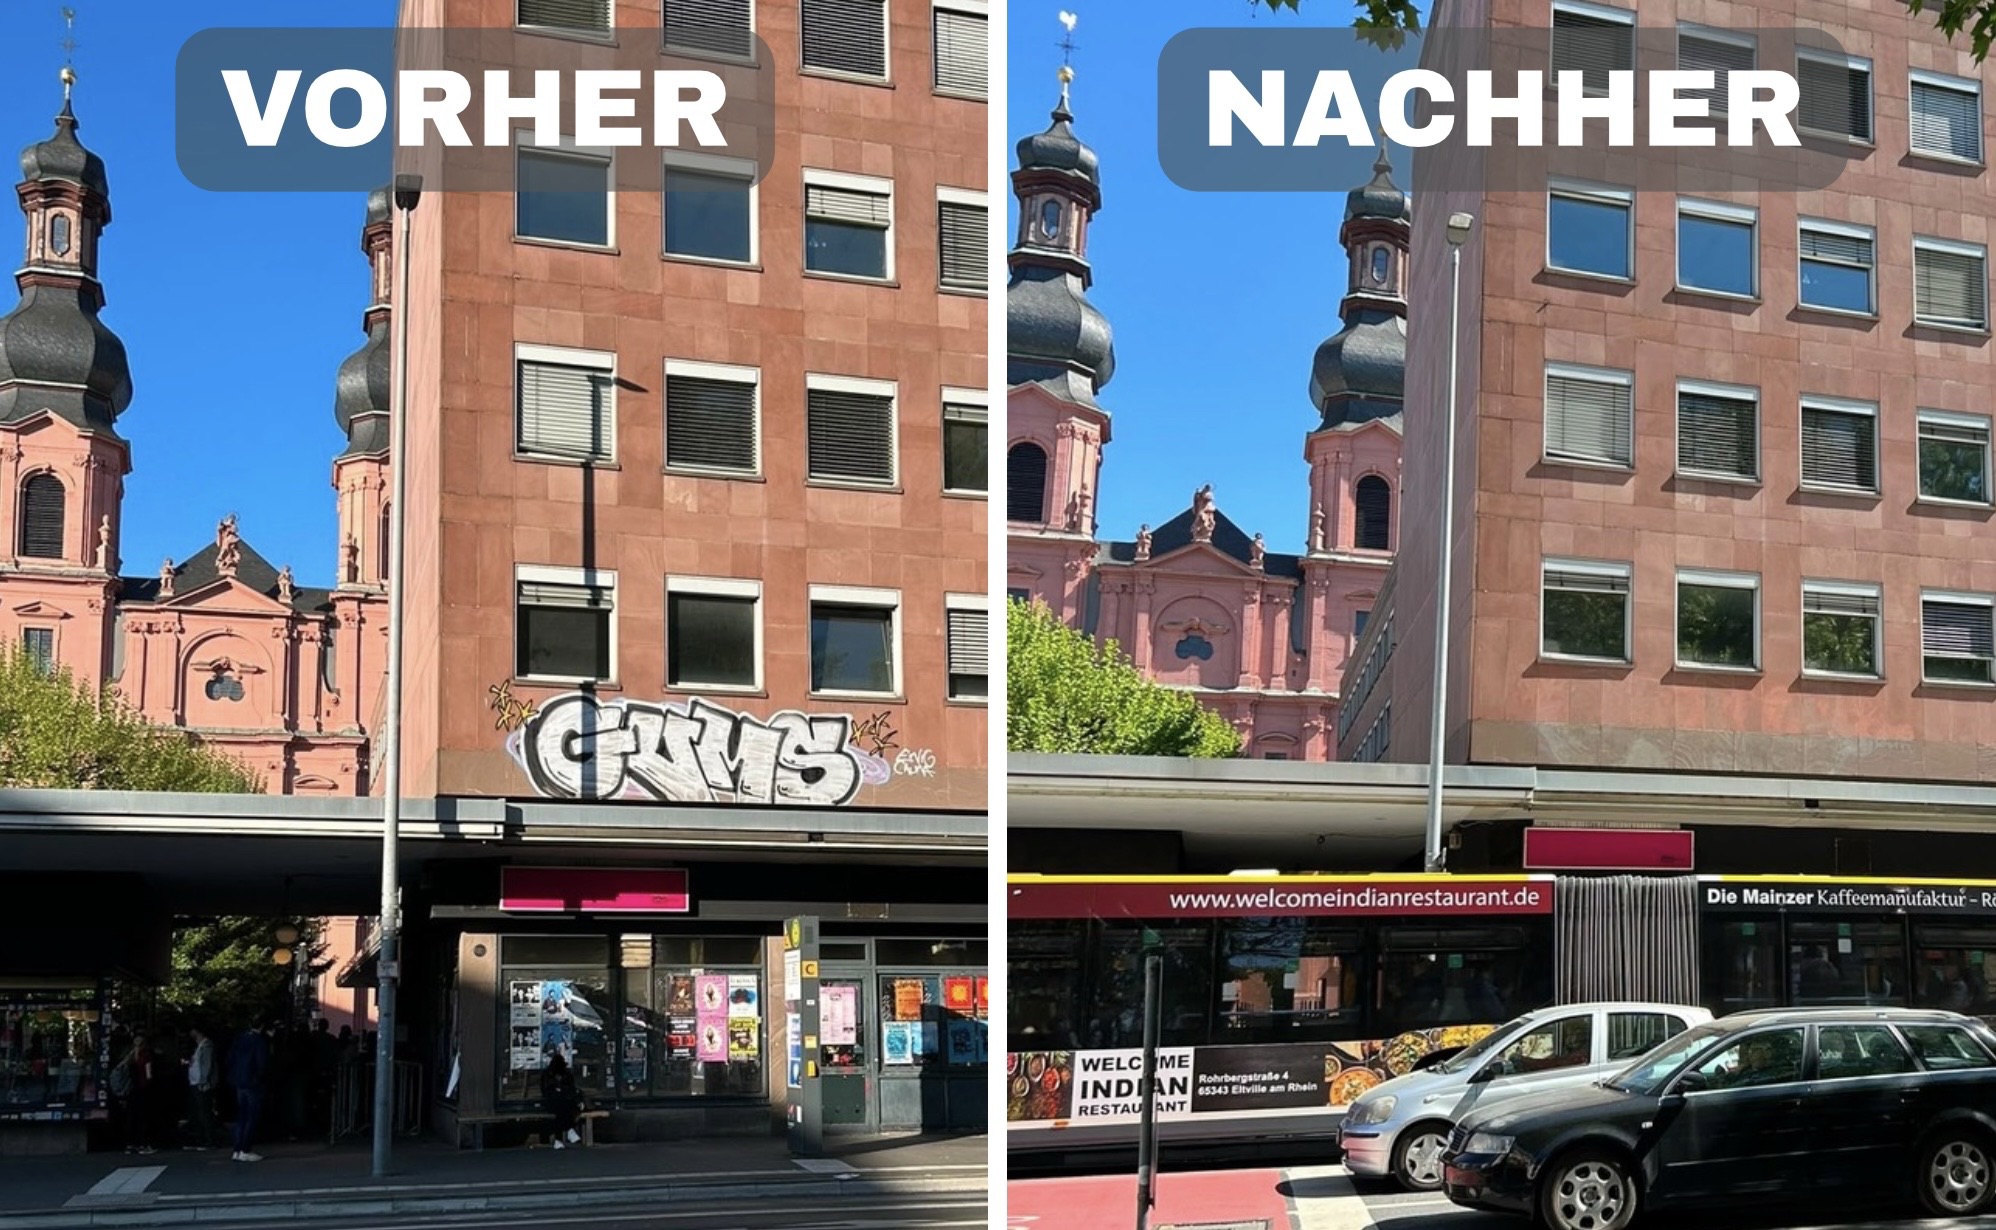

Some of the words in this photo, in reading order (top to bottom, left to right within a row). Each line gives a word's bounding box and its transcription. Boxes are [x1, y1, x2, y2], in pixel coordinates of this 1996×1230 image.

[1170, 887, 1540, 909] www.welcomeindianrestaurant.de
[1707, 888, 1738, 905] Die
[1743, 889, 1814, 905] Mainzer
[1816, 889, 1967, 908] Kaffeemanufaktur
[805, 963, 815, 975] C
[1081, 1054, 1190, 1072] WELCME
[1198, 1071, 1280, 1084] Rohrbergstraße
[1281, 1070, 1290, 1080] 4
[1198, 1085, 1230, 1096] 65343
[1231, 1083, 1267, 1095] Eltville
[1269, 1085, 1286, 1093] am
[1287, 1081, 1318, 1092] Rhein
[1078, 1100, 1188, 1116] RESTAUANT
